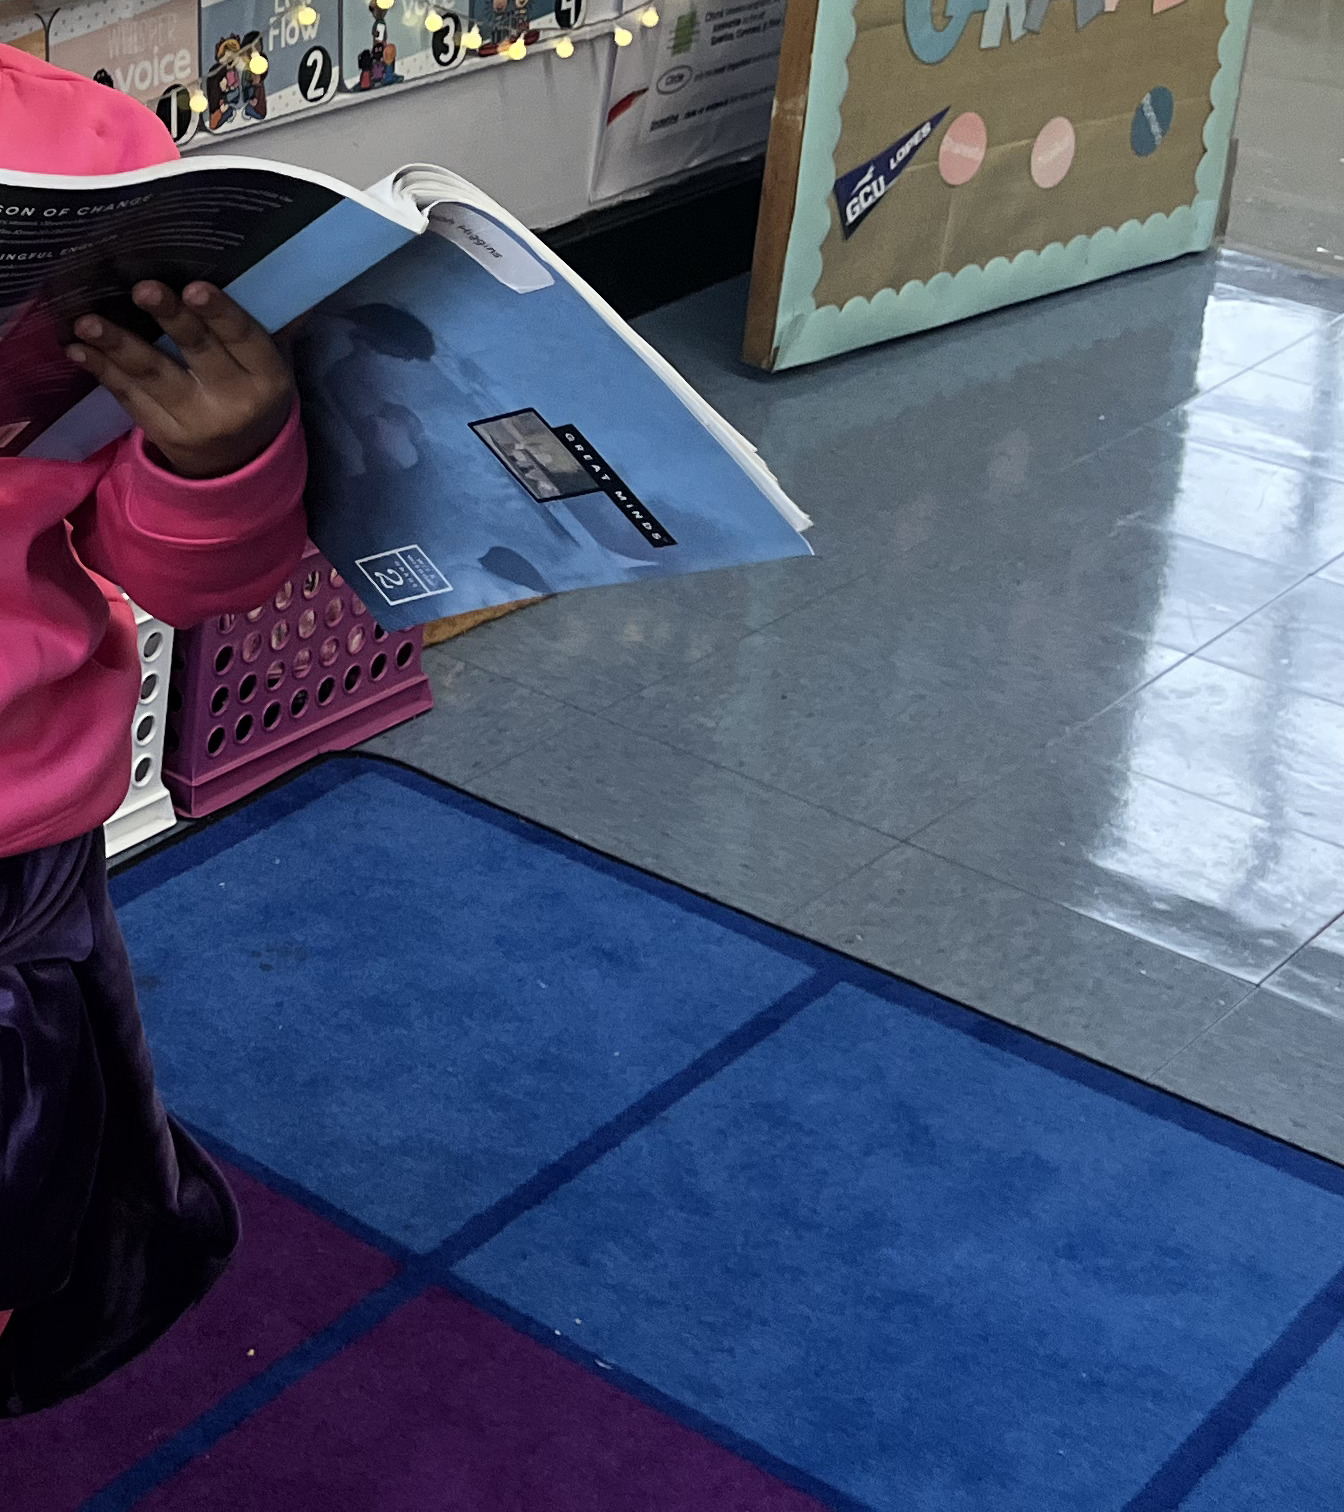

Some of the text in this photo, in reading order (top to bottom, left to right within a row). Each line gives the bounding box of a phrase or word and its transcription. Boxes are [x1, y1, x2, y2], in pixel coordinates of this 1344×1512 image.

[440, 17, 456, 60] 3
[113, 46, 192, 95] voice
[306, 51, 324, 97] 2
[889, 121, 931, 170] LOPES
[43, 207, 70, 217] OF
[845, 176, 886, 226] GCU
[457, 225, 503, 259] Higgins
[564, 433, 662, 540] GREAT MINDS
